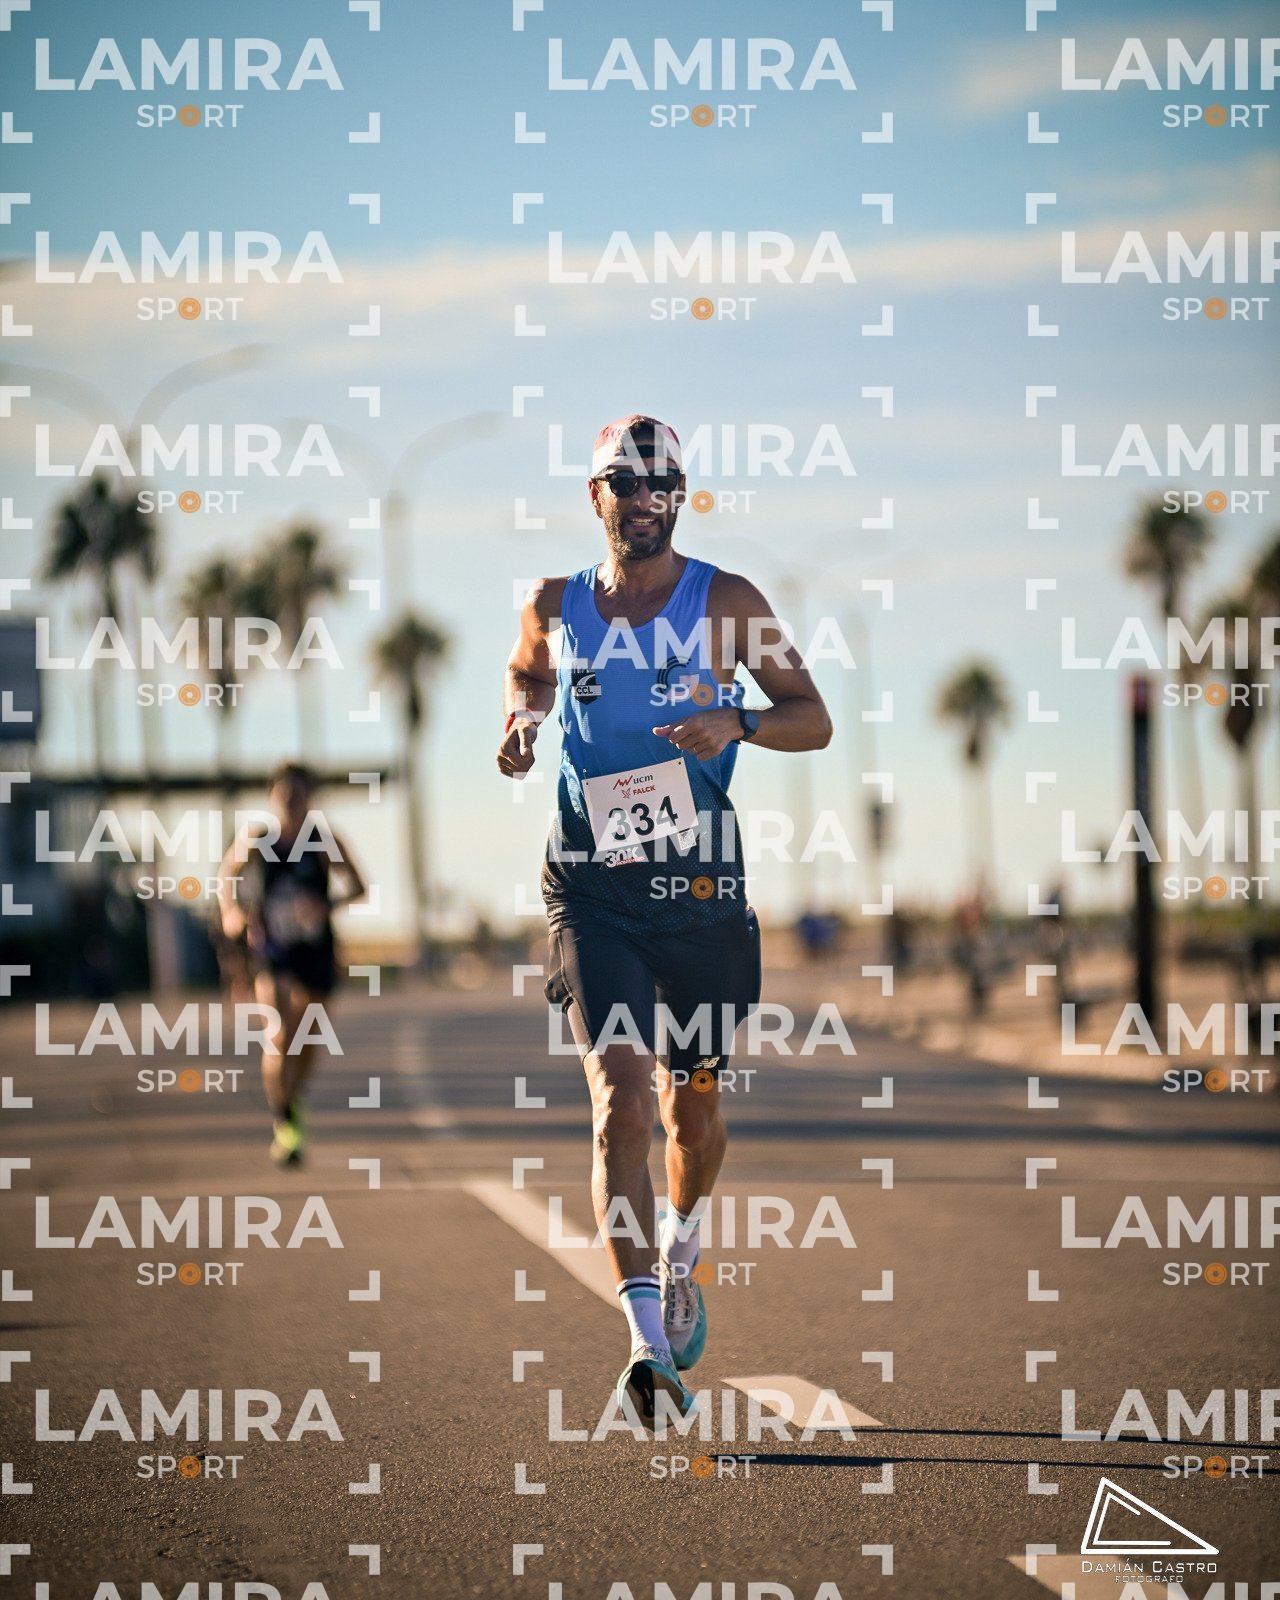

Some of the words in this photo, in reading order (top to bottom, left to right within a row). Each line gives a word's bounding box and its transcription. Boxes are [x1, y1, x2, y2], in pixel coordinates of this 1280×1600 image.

[576, 686, 594, 695] CCL
[633, 774, 654, 784] ucm
[632, 785, 656, 796] FALCK
[608, 795, 679, 843] 334
[604, 846, 639, 868] 30K
